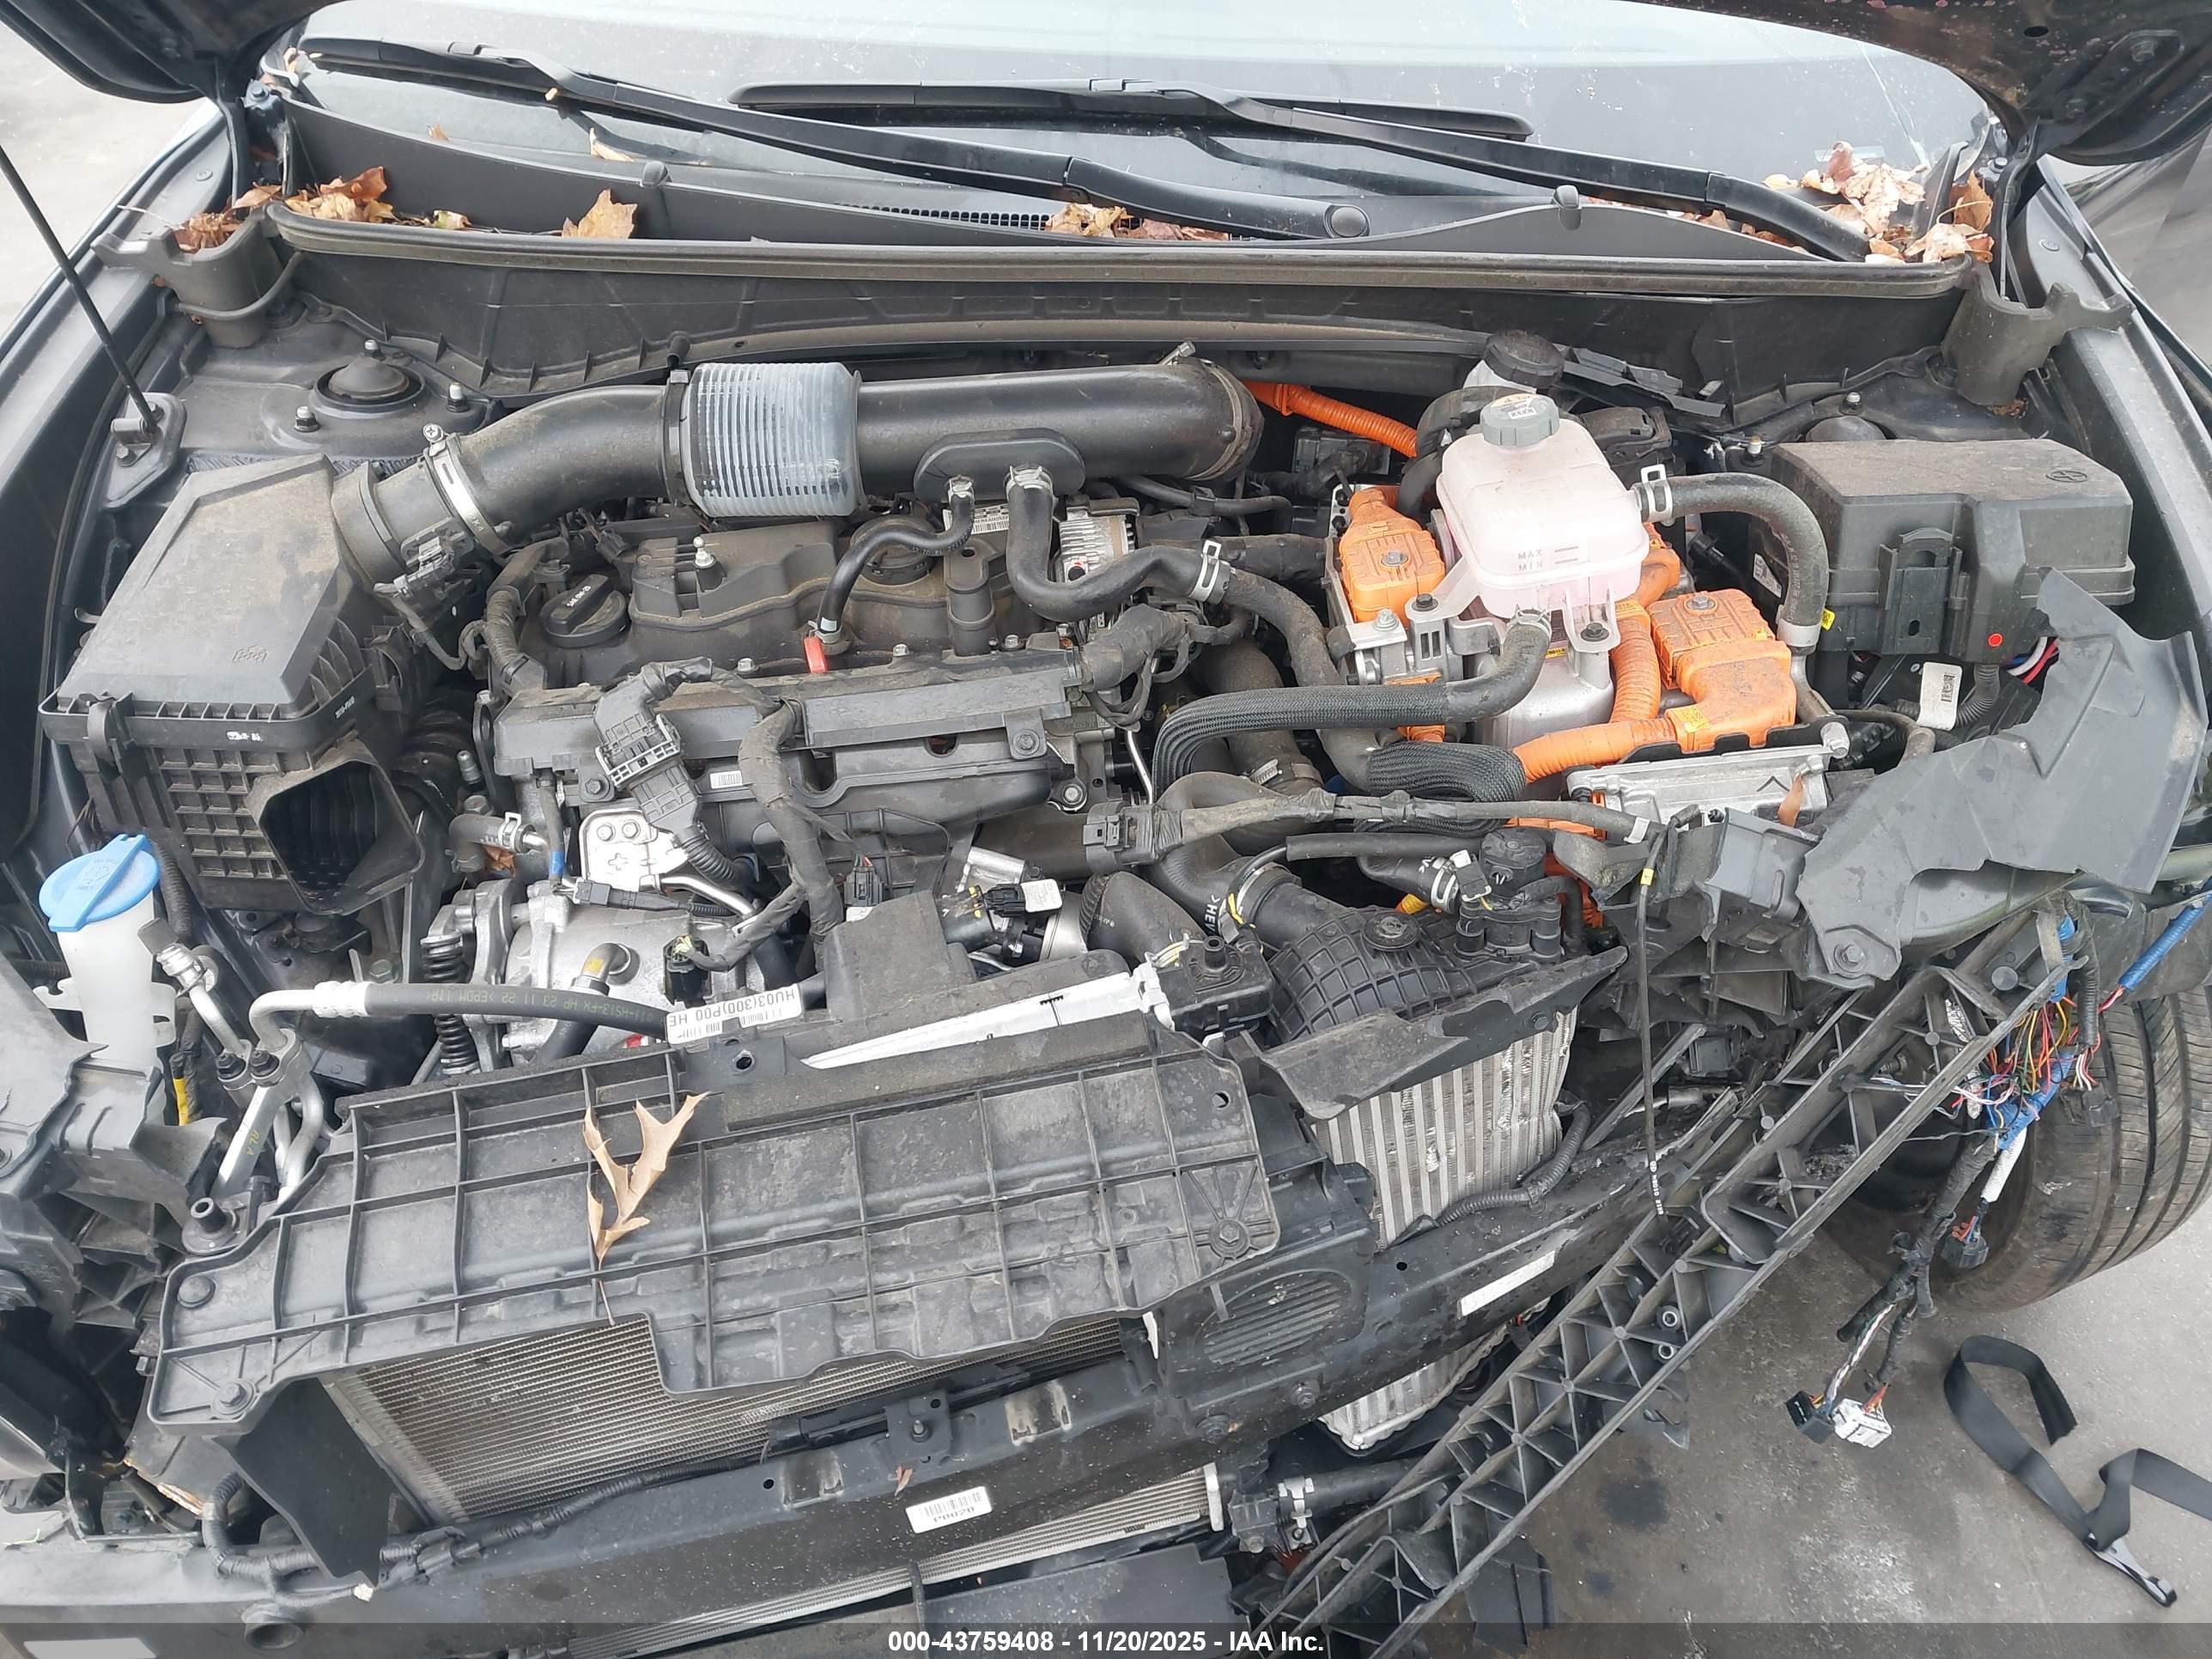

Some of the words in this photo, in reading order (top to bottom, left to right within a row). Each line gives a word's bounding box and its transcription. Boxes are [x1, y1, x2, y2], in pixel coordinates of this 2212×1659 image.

[1517, 550, 1542, 560] MAX
[1518, 561, 1544, 572] MIN
[501, 991, 516, 1004] 22
[696, 988, 795, 1021] HU03(300)P00
[668, 1013, 689, 1027] HE
